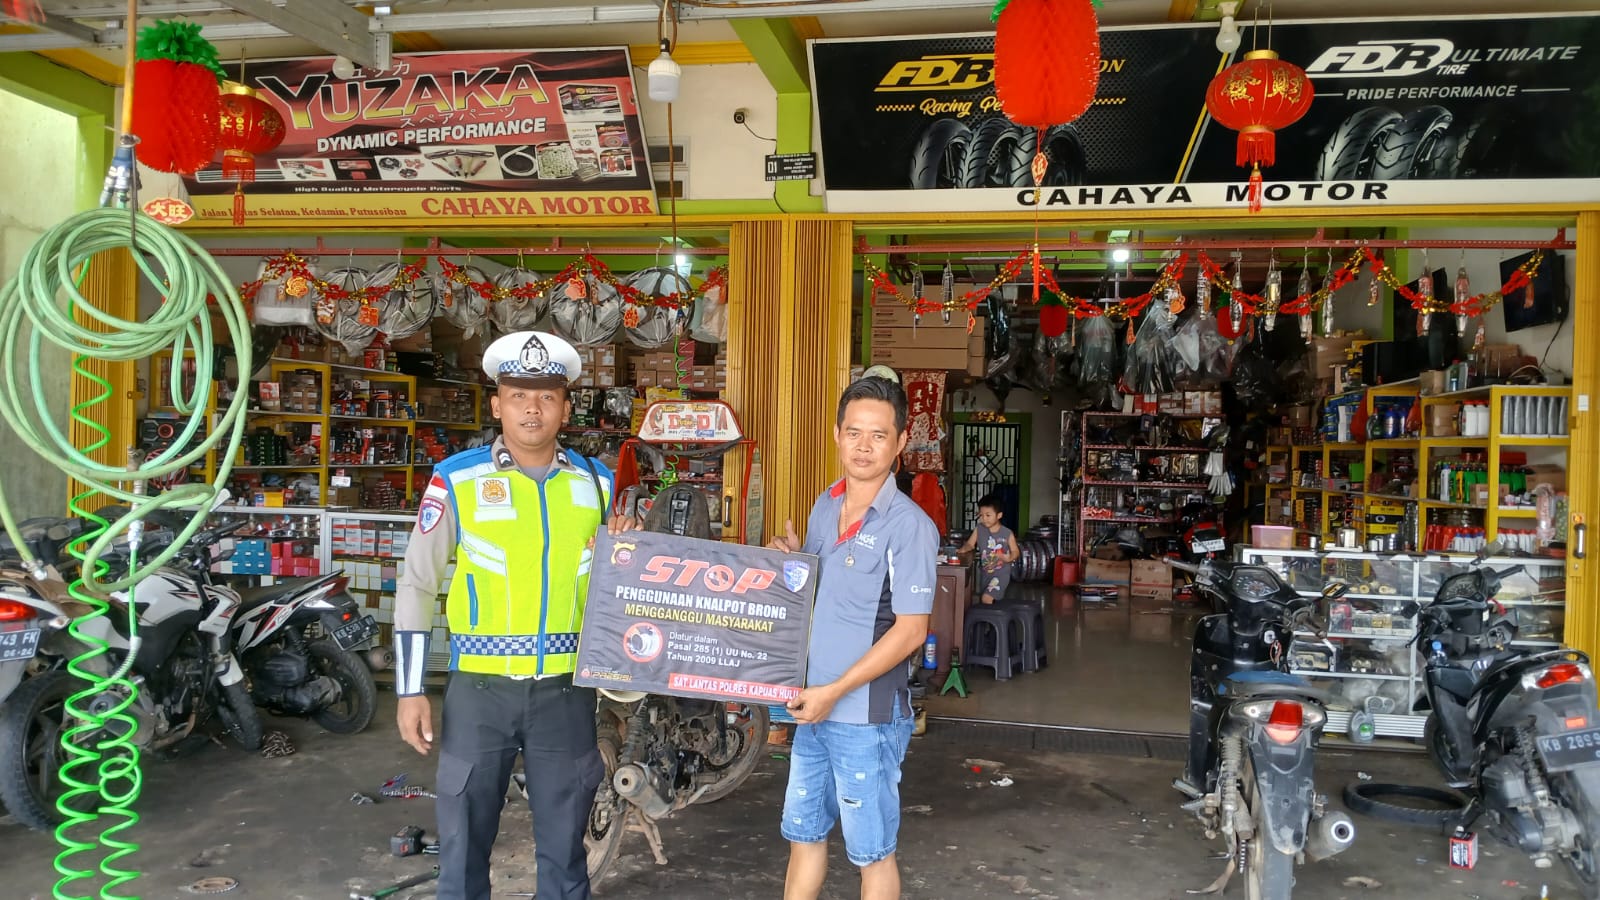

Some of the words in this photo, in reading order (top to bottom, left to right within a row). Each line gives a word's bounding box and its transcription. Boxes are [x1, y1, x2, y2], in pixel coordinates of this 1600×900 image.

[1305, 38, 1455, 78] FDR
[1451, 45, 1582, 63] ULTIMATE
[873, 53, 995, 92] FDR
[1436, 63, 1470, 75] TIRE
[254, 63, 550, 129] YUZAKA
[1346, 87, 1395, 100] PRIDE
[1397, 85, 1518, 99] PERFORMANCE
[400, 106, 516, 129] スペアパーツ
[919, 98, 971, 118] Racing
[316, 131, 398, 153] DYNAMIC
[404, 117, 547, 145] PERFORMANCE
[1016, 185, 1192, 206] CAHAYA
[149, 201, 188, 219] 大旺
[201, 208, 227, 217] Jalan
[260, 208, 300, 218] Selatan,
[302, 207, 348, 217] Kedamin,
[350, 207, 408, 216] Putussibau
[421, 197, 537, 216] CAHAYA
[539, 196, 653, 215] MOTOR
[640, 555, 777, 594] STOP
[615, 585, 693, 608] PENGGUNAAN
[695, 596, 747, 614] KNALPOT
[748, 602, 787, 620] BRONG
[624, 603, 703, 625] MENGGANGGU
[705, 613, 774, 633] MASYARAKAT
[694, 633, 718, 645] dalam
[667, 651, 693, 663] Tahun
[695, 654, 716, 665] 2009
[718, 656, 741, 668] LLAJ
[668, 641, 692, 653] Pasal
[693, 643, 710, 655] 285
[711, 645, 724, 657] (1)
[725, 647, 739, 657] UU
[740, 648, 755, 660] No.
[757, 651, 768, 661] 22
[673, 676, 688, 688] SAT
[688, 678, 717, 691] LANTAS
[719, 681, 747, 695] POLRES
[748, 685, 778, 698] KAPUAS
[1542, 737, 1562, 752] KB
